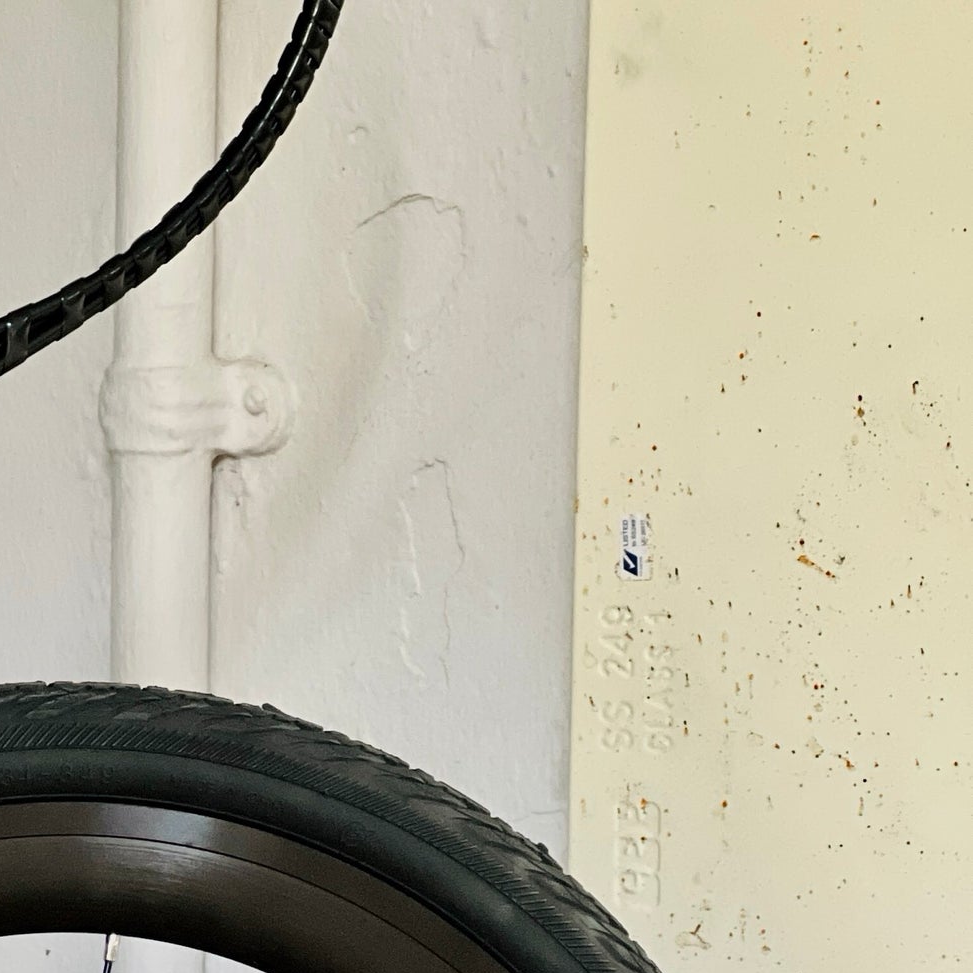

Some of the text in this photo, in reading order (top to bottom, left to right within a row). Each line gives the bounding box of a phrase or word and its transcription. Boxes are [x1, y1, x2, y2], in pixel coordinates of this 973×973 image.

[621, 519, 629, 547] LISTED
[598, 605, 633, 752] SS 249
